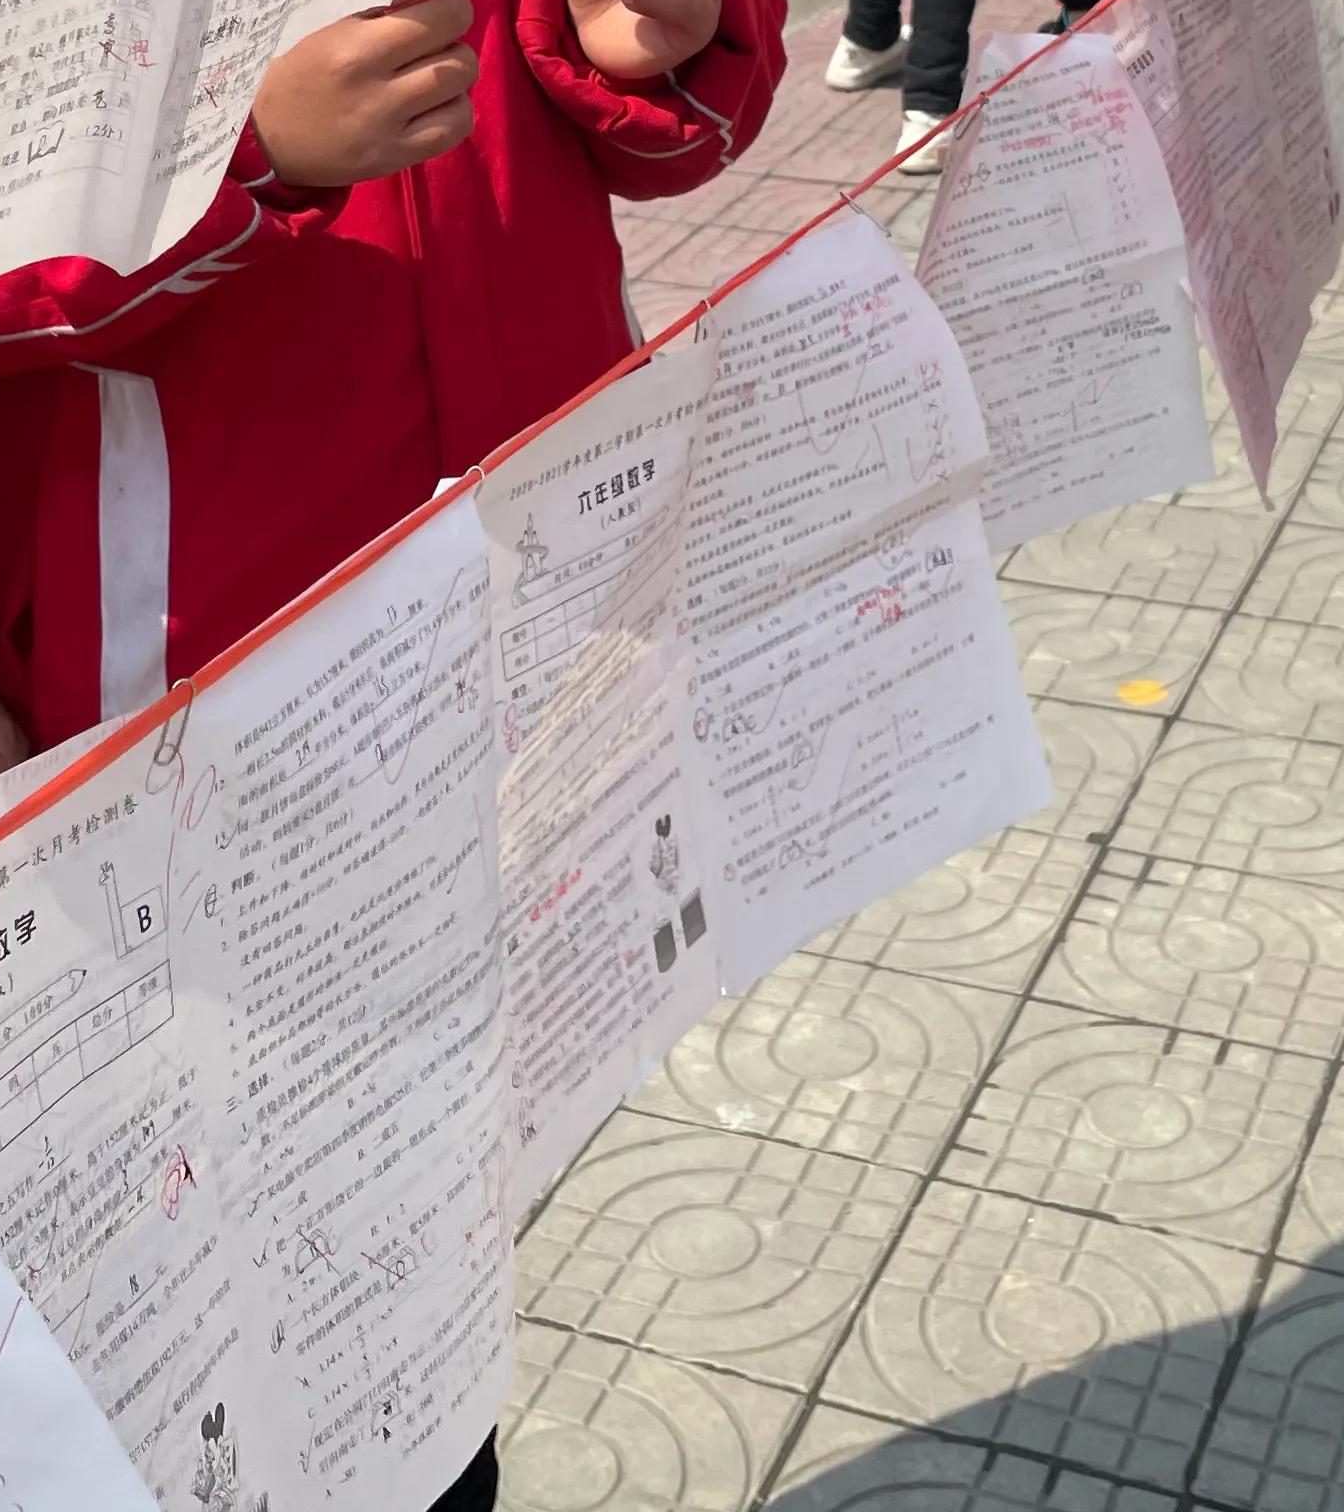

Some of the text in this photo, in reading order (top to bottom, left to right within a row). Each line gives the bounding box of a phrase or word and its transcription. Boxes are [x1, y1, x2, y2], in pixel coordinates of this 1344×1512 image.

[576, 457, 657, 516] 六年级数学
[136, 903, 154, 935] B
